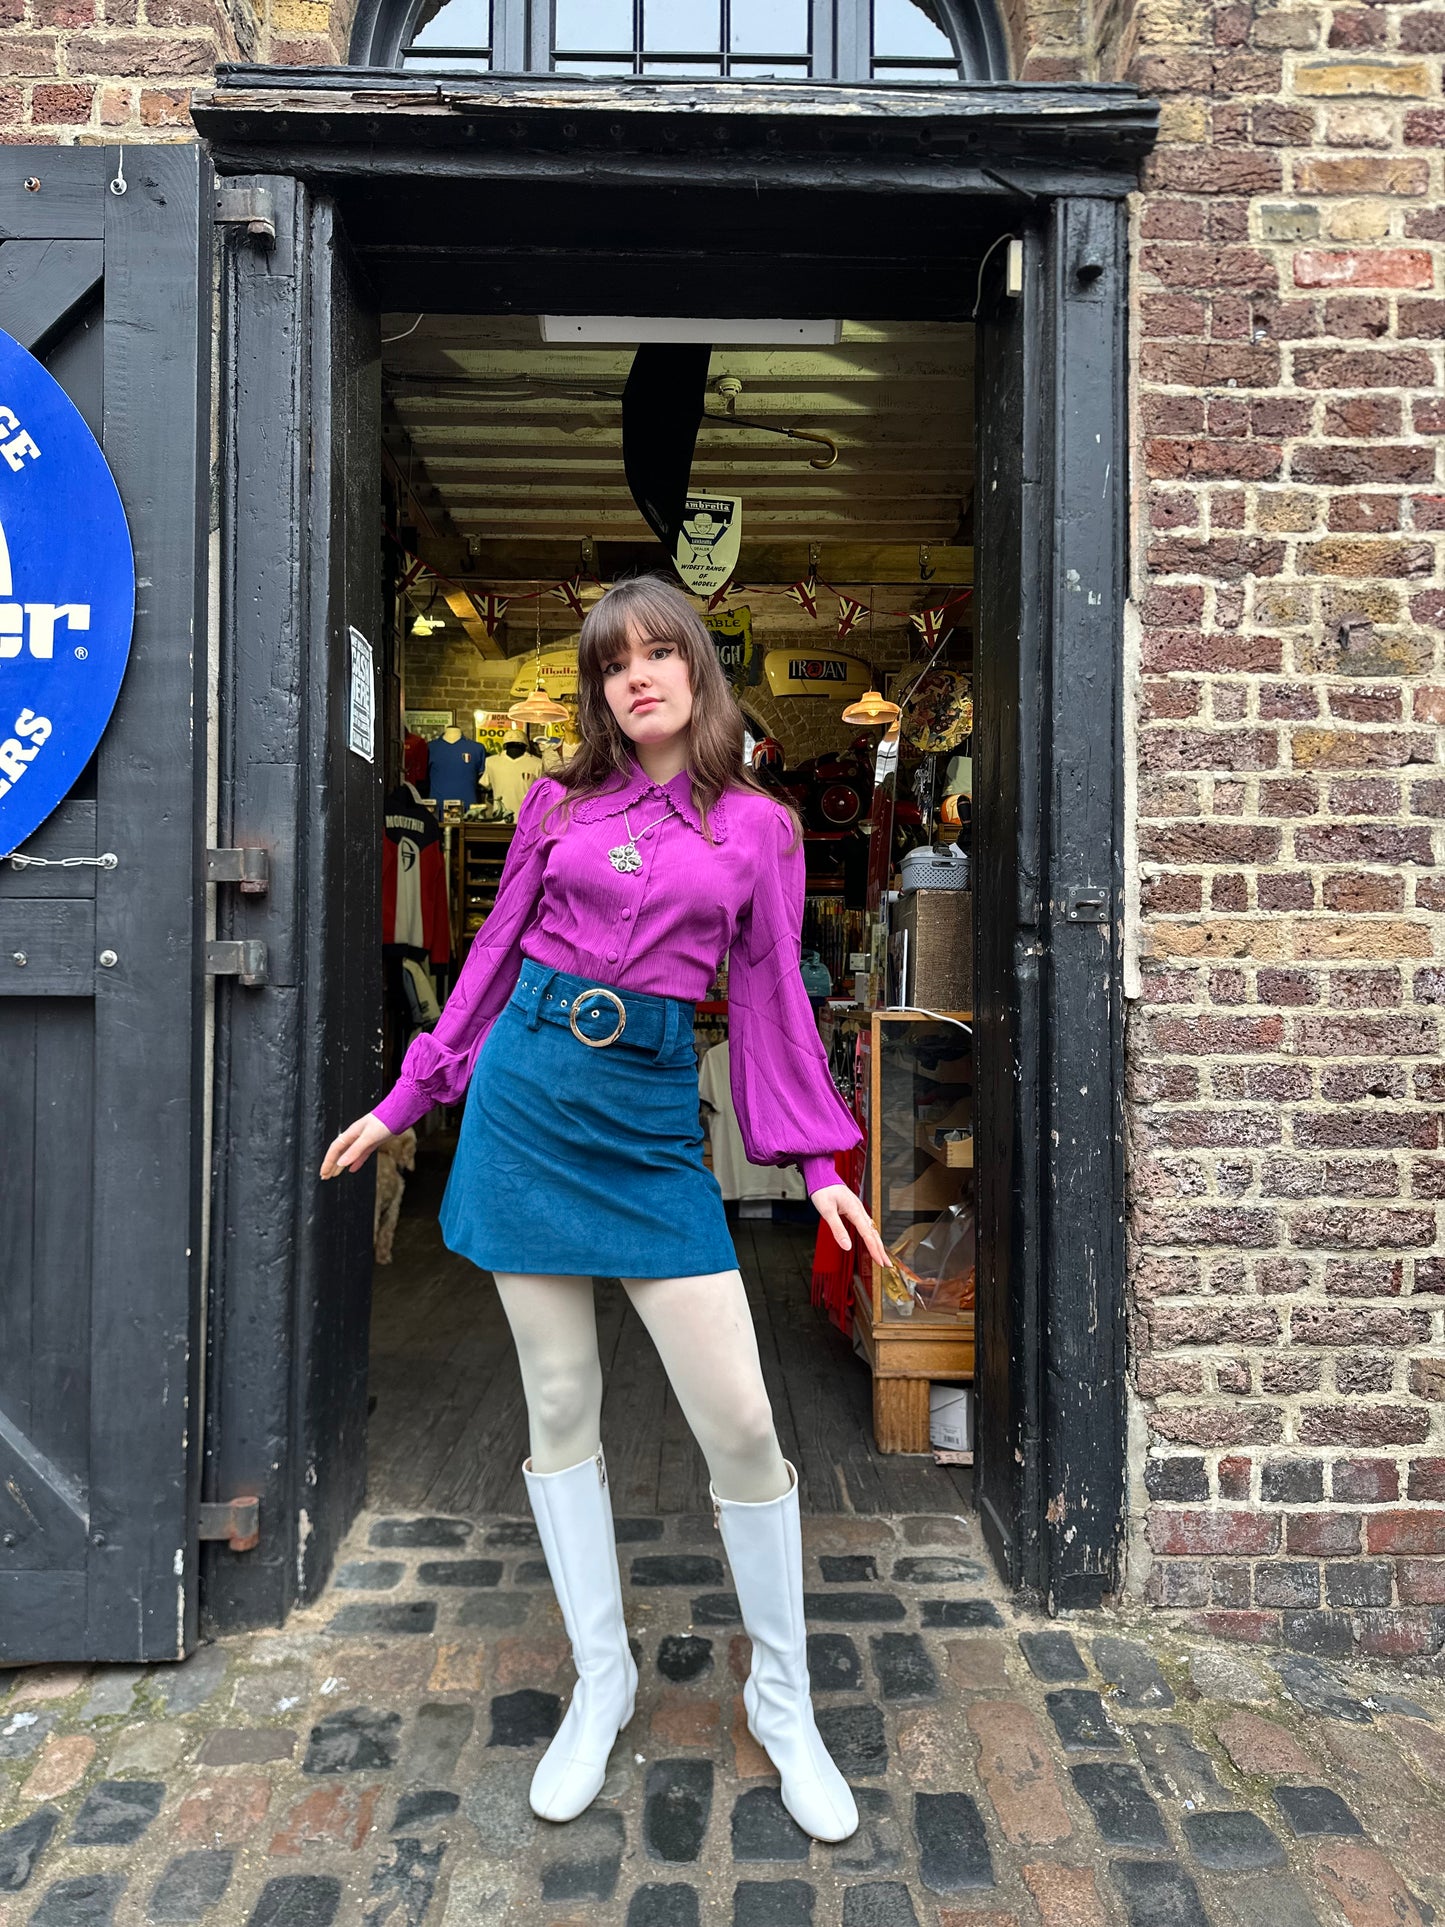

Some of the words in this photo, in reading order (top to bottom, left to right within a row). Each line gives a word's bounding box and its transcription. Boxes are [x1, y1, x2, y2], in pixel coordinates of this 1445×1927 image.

[685, 500, 730, 512] ambretta
[789, 660, 846, 680] TROJAN
[479, 729, 507, 737] DOO
